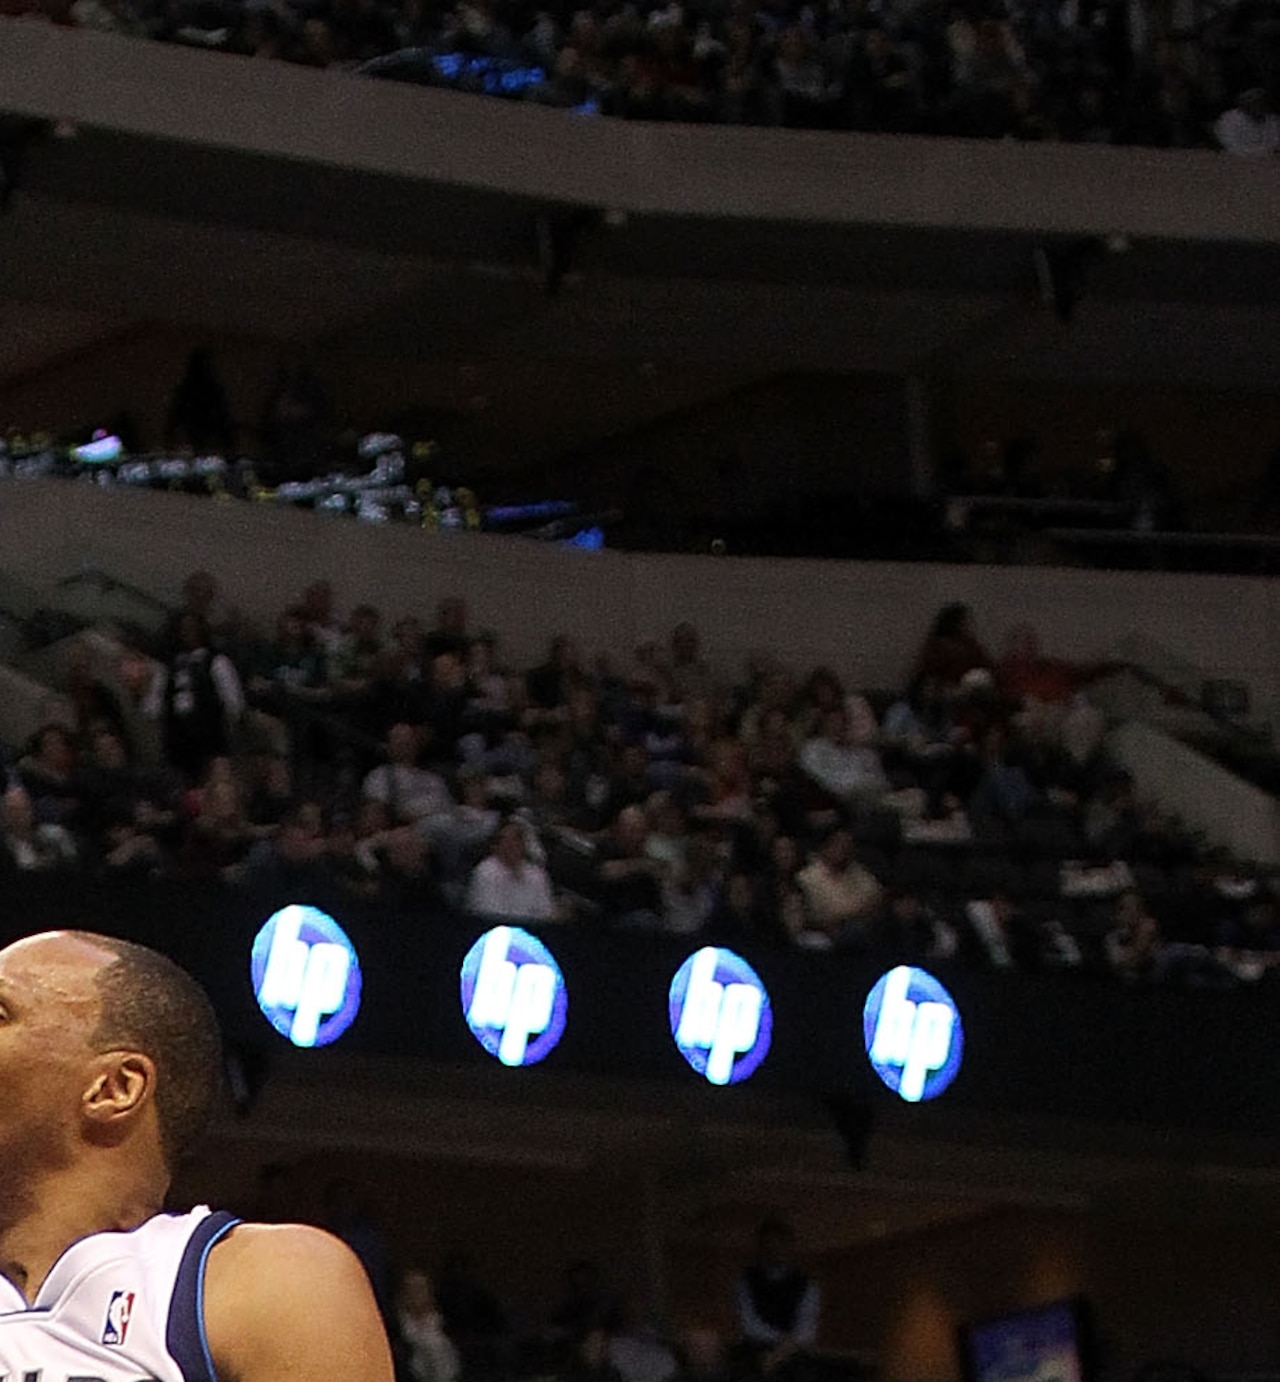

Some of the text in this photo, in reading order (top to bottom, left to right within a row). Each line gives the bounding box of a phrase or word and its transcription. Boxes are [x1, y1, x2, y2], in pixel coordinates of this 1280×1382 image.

[258, 904, 350, 1048] hp
[470, 924, 555, 1067] hp
[675, 945, 761, 1086] hp
[870, 964, 954, 1103] hp
